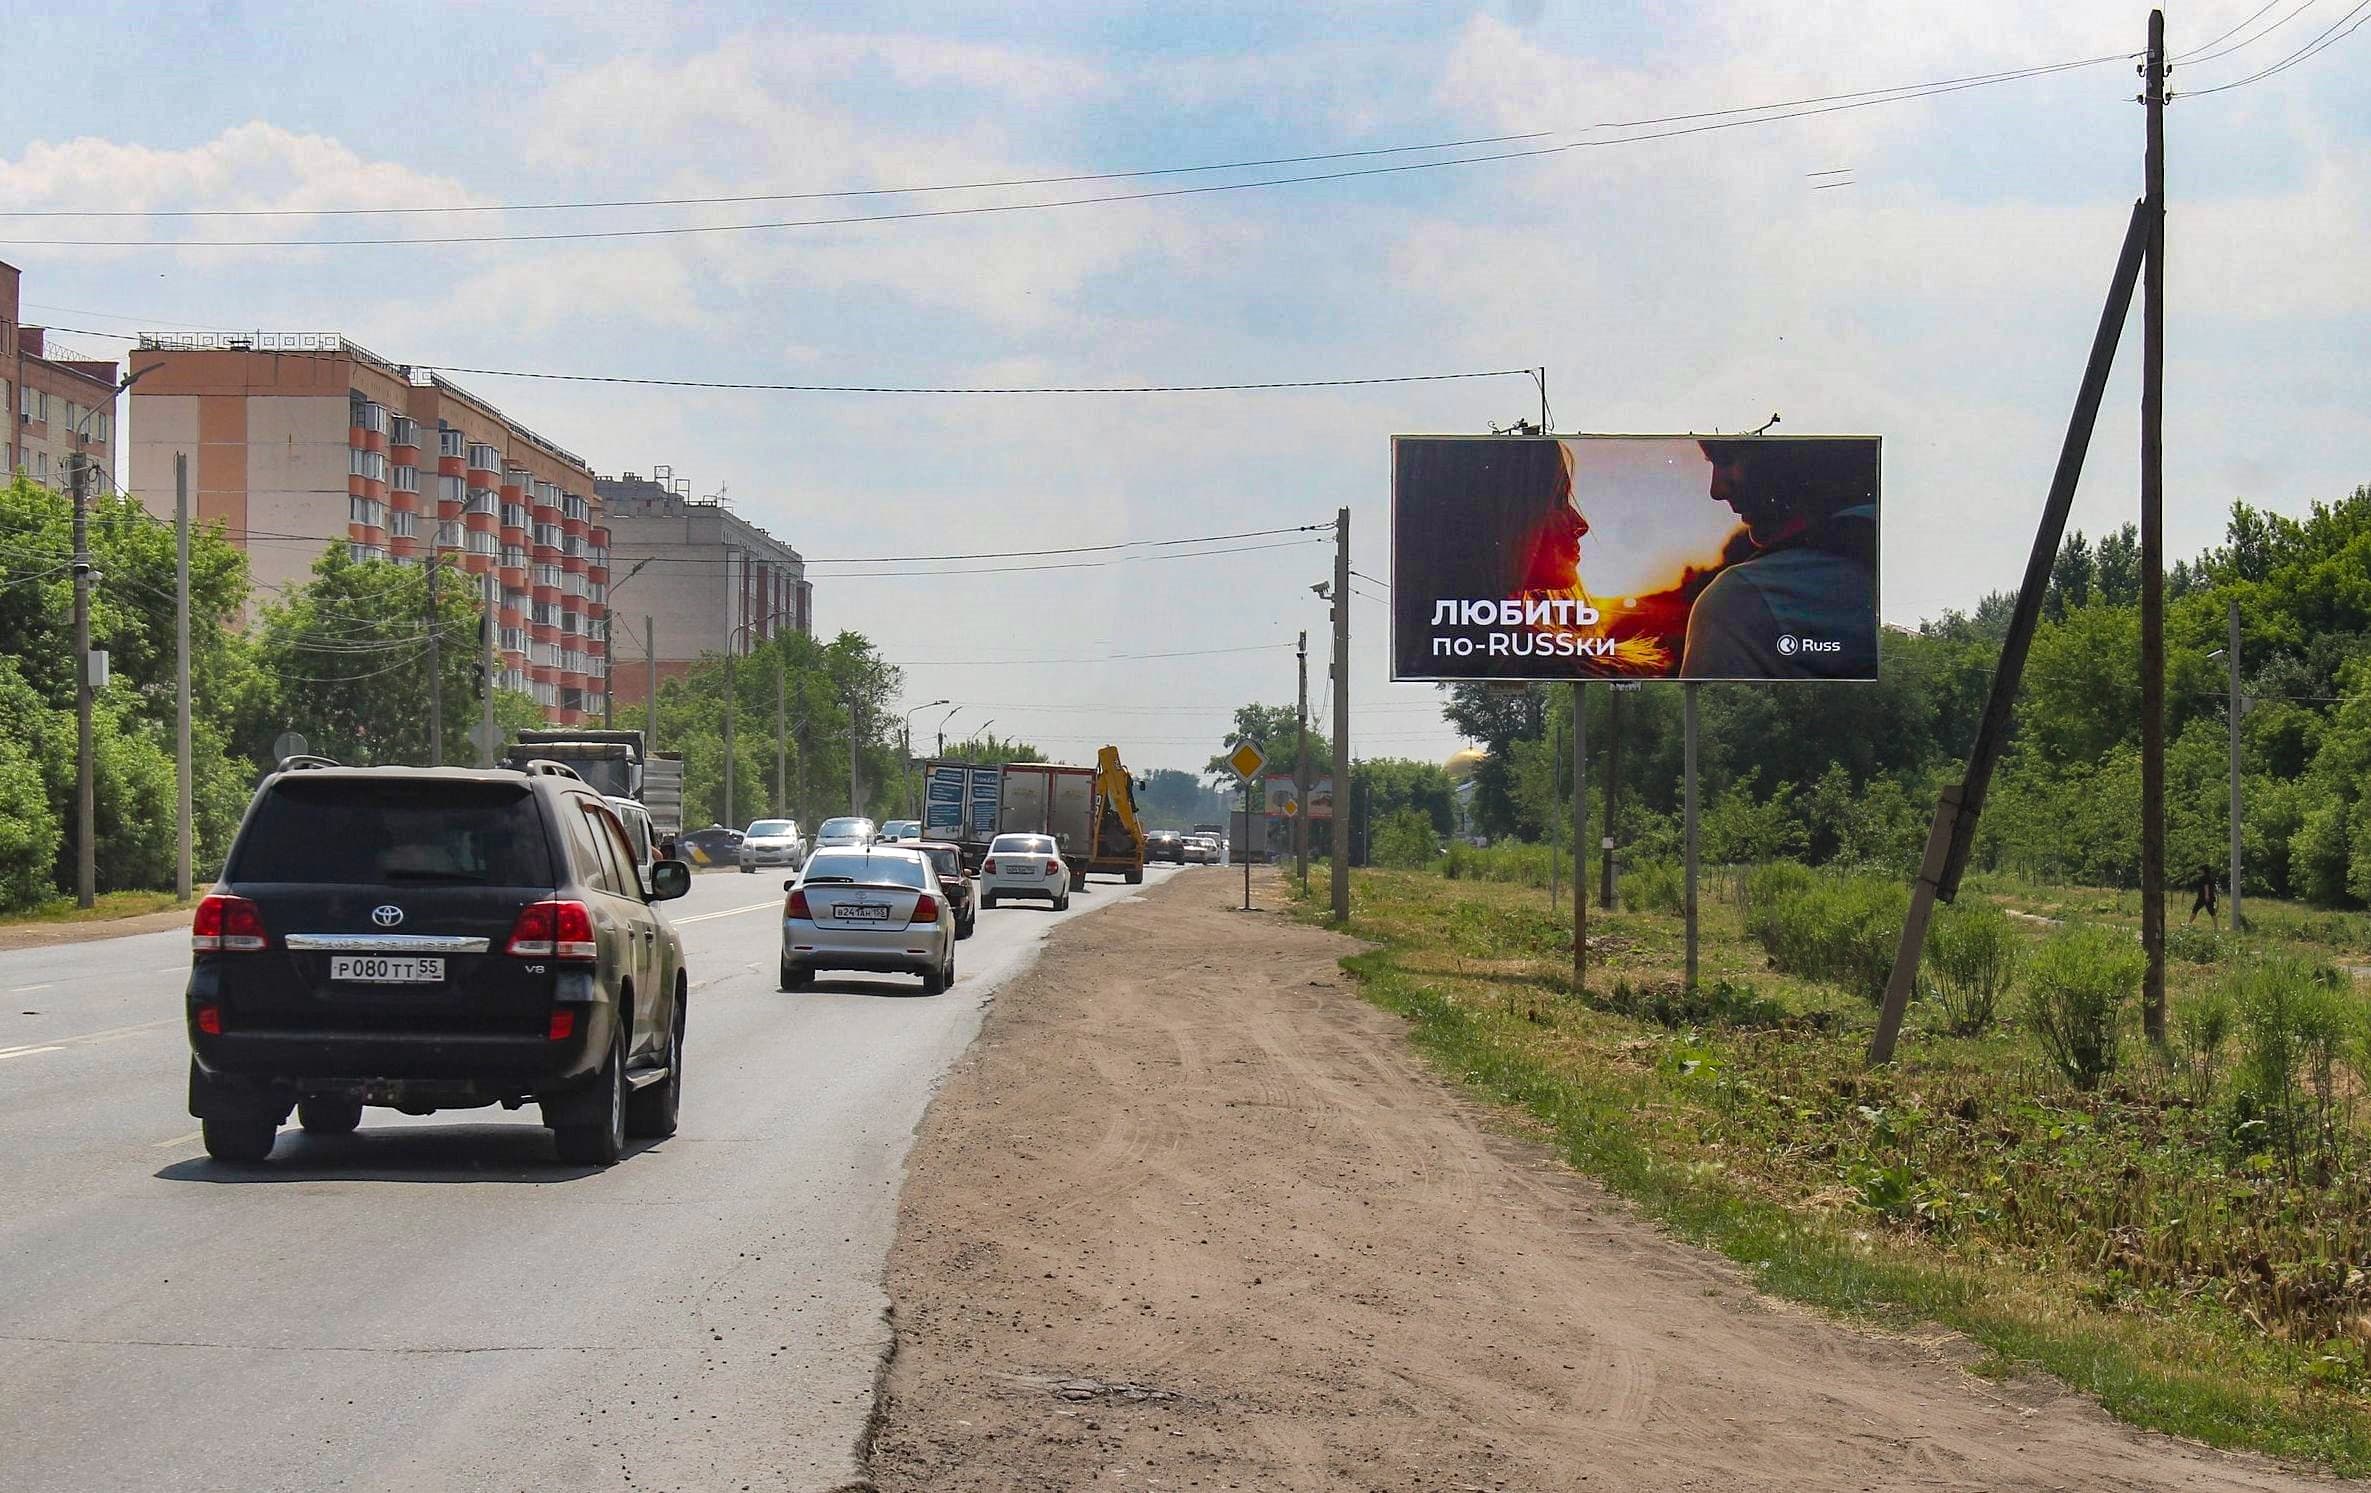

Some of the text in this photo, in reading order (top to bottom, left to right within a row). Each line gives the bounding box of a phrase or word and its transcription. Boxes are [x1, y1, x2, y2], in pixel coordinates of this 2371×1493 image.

[1431, 599, 1600, 626] ЛЮБИТЬ
[1433, 632, 1615, 656] по-RUSSки
[1802, 638, 1841, 652] Russ
[419, 959, 438, 974] 55
[524, 964, 545, 974] V8
